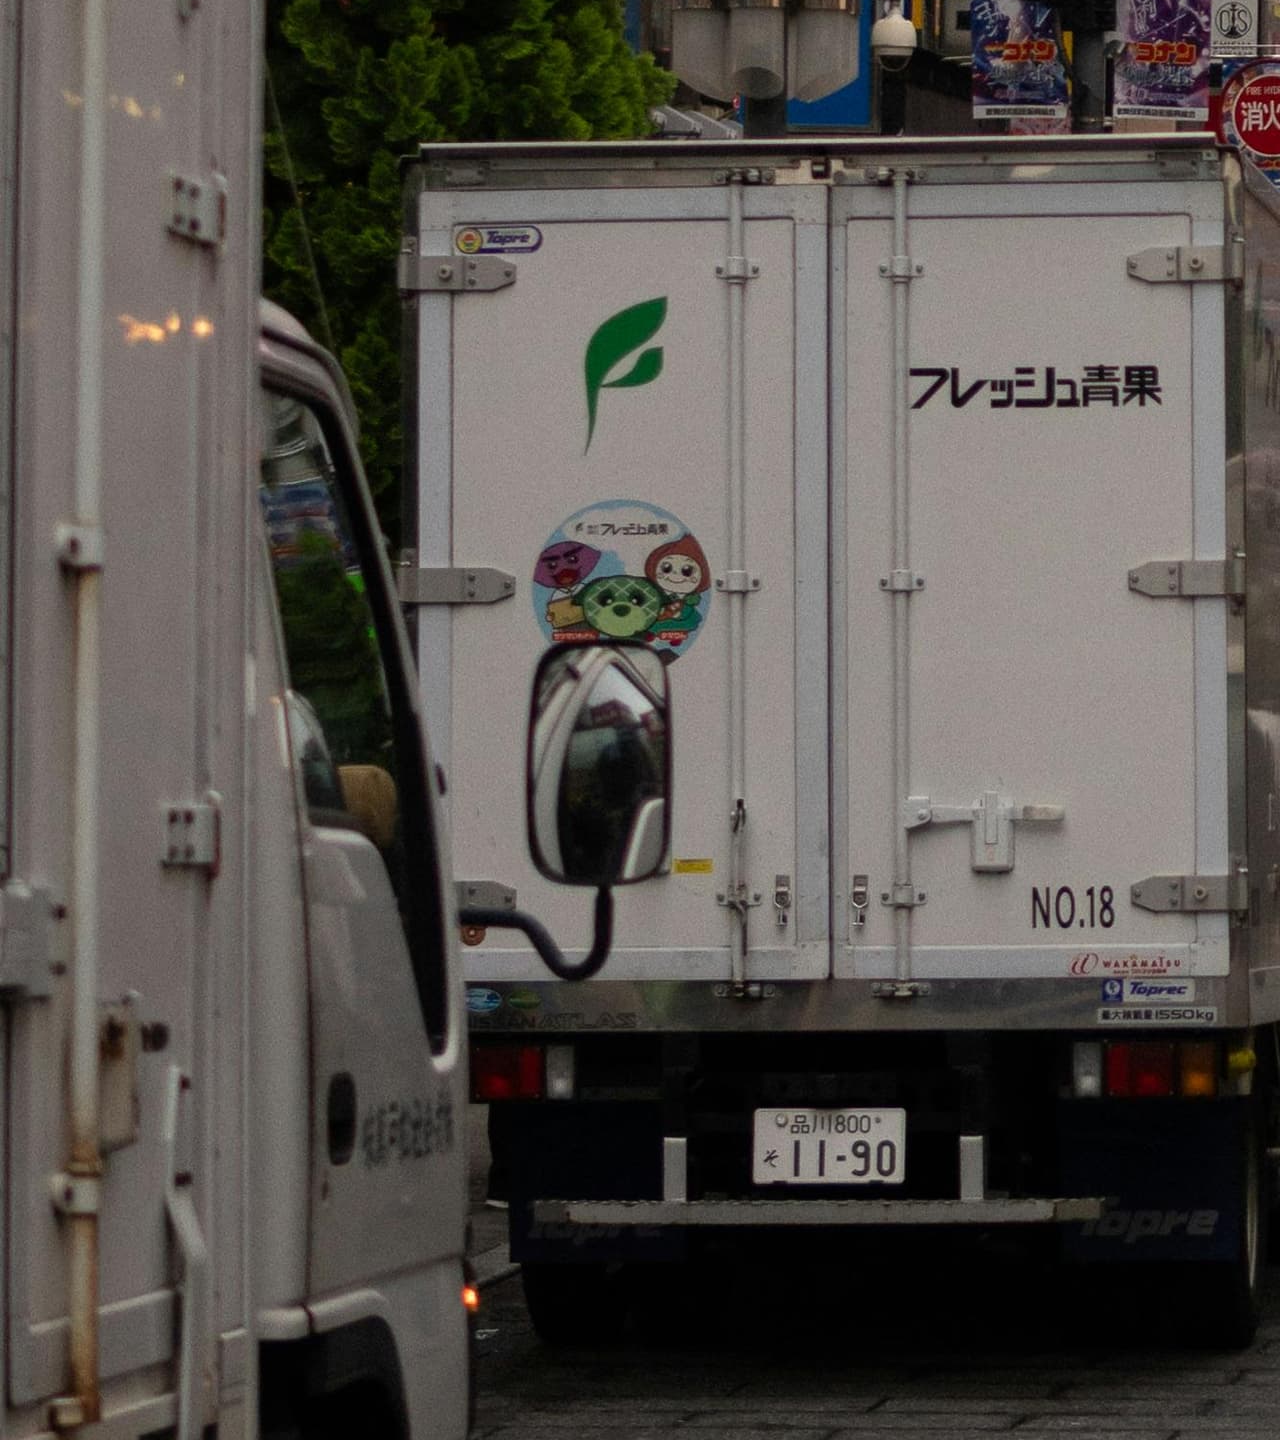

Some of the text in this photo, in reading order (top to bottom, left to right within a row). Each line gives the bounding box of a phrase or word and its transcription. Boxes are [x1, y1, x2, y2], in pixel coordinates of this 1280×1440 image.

[1246, 85, 1264, 96] FIRE
[486, 230, 531, 249] Topre
[909, 366, 1163, 409] フレッシュ青果
[1030, 884, 1116, 930] NO.18
[1129, 981, 1188, 997] Toprec
[789, 1114, 872, 1135] 品川 800
[793, 1138, 898, 1179] 11-90
